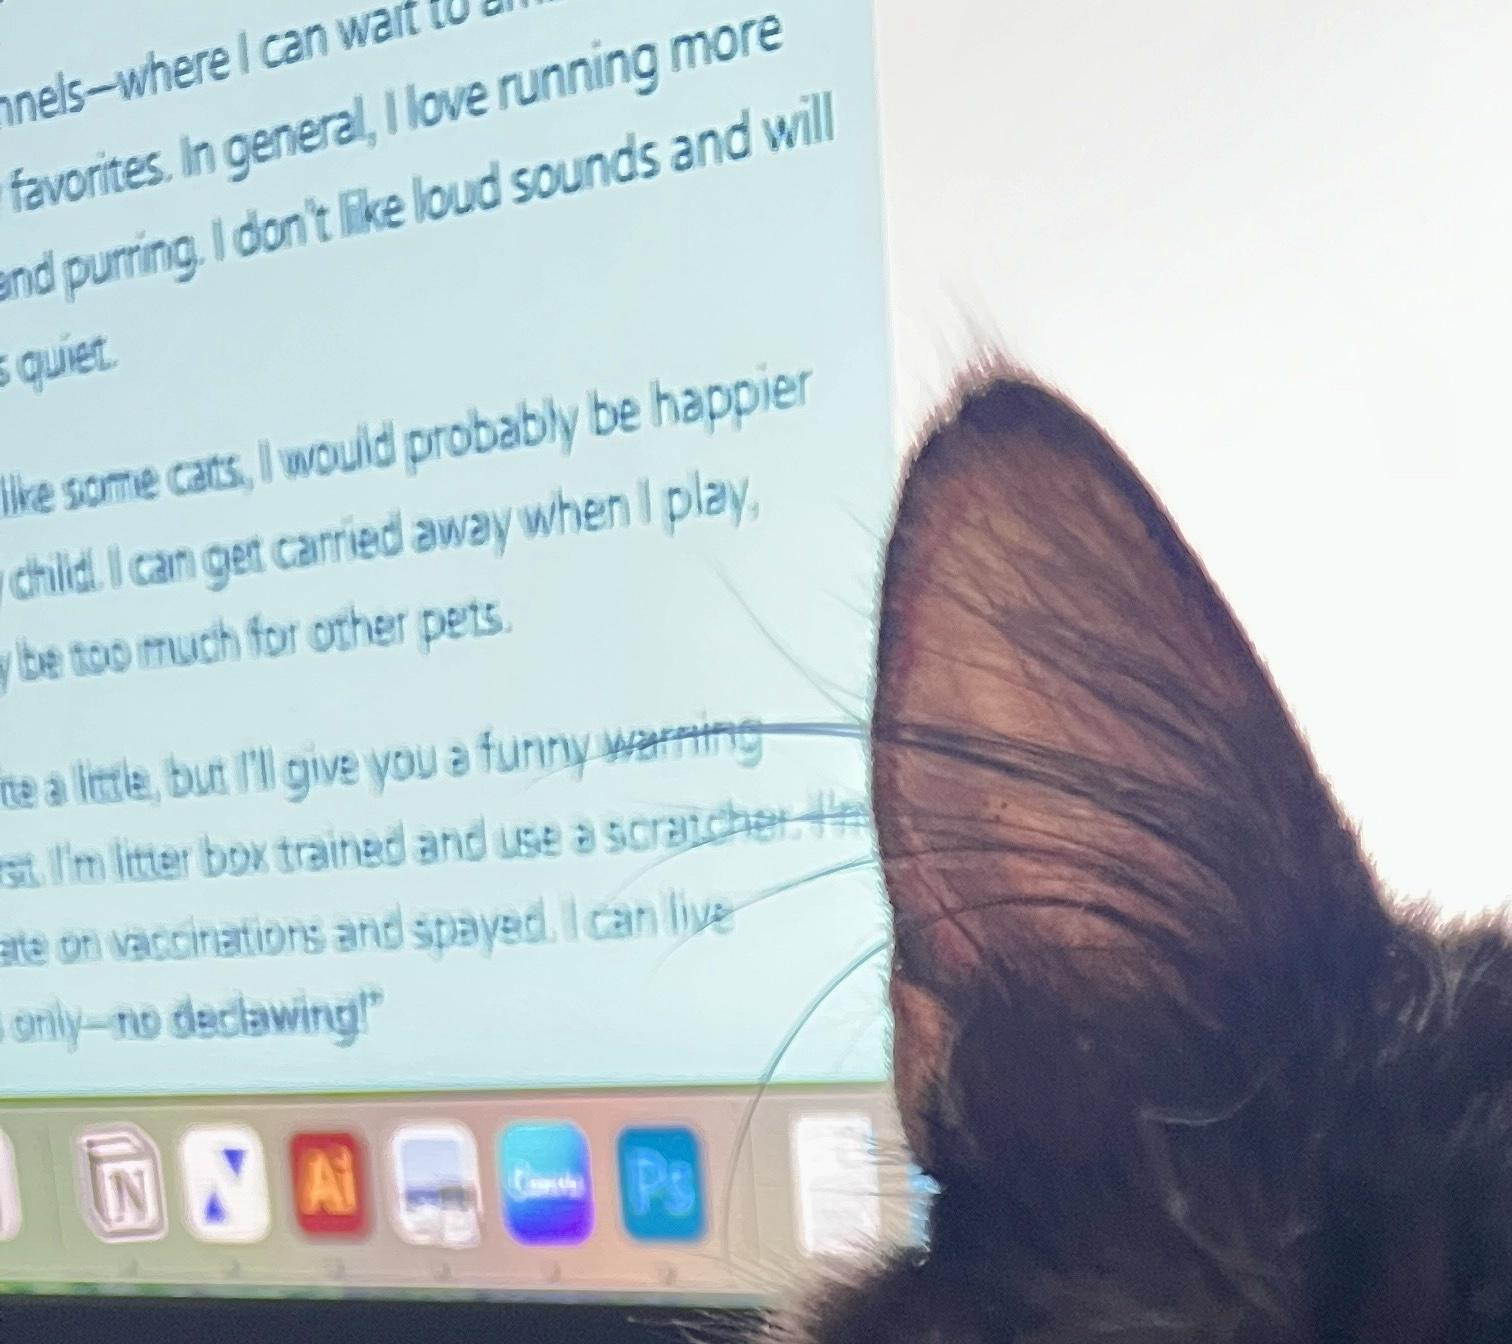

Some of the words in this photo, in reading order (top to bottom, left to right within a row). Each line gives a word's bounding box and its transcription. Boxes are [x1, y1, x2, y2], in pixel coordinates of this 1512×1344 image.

[237, 29, 251, 75] I
[259, 21, 329, 70] can
[337, 0, 420, 50] wait
[429, 0, 471, 30] to
[10, 150, 173, 214] favorites.
[179, 132, 216, 179] In
[222, 92, 378, 184] general,
[384, 88, 398, 136] I
[406, 80, 489, 131] love
[496, 37, 661, 110] running
[669, 12, 784, 73] more
[0, 248, 57, 302] and
[62, 229, 205, 303] purring.
[211, 216, 226, 262] I
[232, 196, 333, 259] don't
[338, 186, 406, 238] like
[412, 159, 502, 222] loud
[511, 129, 662, 206] sounds
[669, 106, 752, 174] and
[762, 88, 836, 153] will
[16, 330, 118, 394] quiet.
[62, 463, 161, 511] some
[164, 450, 255, 498] cats,
[257, 437, 274, 484] I
[278, 420, 398, 480] would
[403, 392, 580, 477] probably
[587, 386, 643, 438] be
[648, 361, 814, 436] happier
[8, 543, 103, 602] child.
[107, 543, 123, 589] I
[127, 544, 197, 588] can
[200, 533, 267, 593] get
[270, 506, 405, 572] carried
[411, 504, 513, 560] away
[519, 485, 632, 540] when
[636, 475, 651, 525] I
[15, 632, 64, 683] be
[68, 635, 133, 676] too
[136, 614, 244, 671] much
[245, 609, 302, 658] for
[306, 599, 409, 655] other
[417, 596, 513, 657] pets.
[44, 770, 68, 808] a
[70, 755, 163, 807] little,
[164, 750, 230, 800] but
[233, 743, 276, 795] I'll
[281, 740, 360, 804] give
[365, 742, 439, 797] you
[447, 743, 471, 777] a
[476, 723, 593, 783] funny
[604, 711, 764, 769] warning
[49, 838, 106, 886] I'm
[111, 834, 193, 883] litter
[200, 830, 270, 880] box
[275, 818, 407, 876] trained
[412, 814, 488, 866] and
[496, 820, 563, 860] use
[572, 818, 597, 856] a
[56, 931, 102, 966] on
[111, 912, 327, 963] vaccinations
[329, 902, 403, 956] and
[410, 895, 557, 962] spayed.
[561, 889, 578, 942] I
[587, 899, 659, 942] can
[667, 887, 737, 937] live
[299, 1144, 359, 1217] Ai
[625, 1145, 697, 1218] Ps
